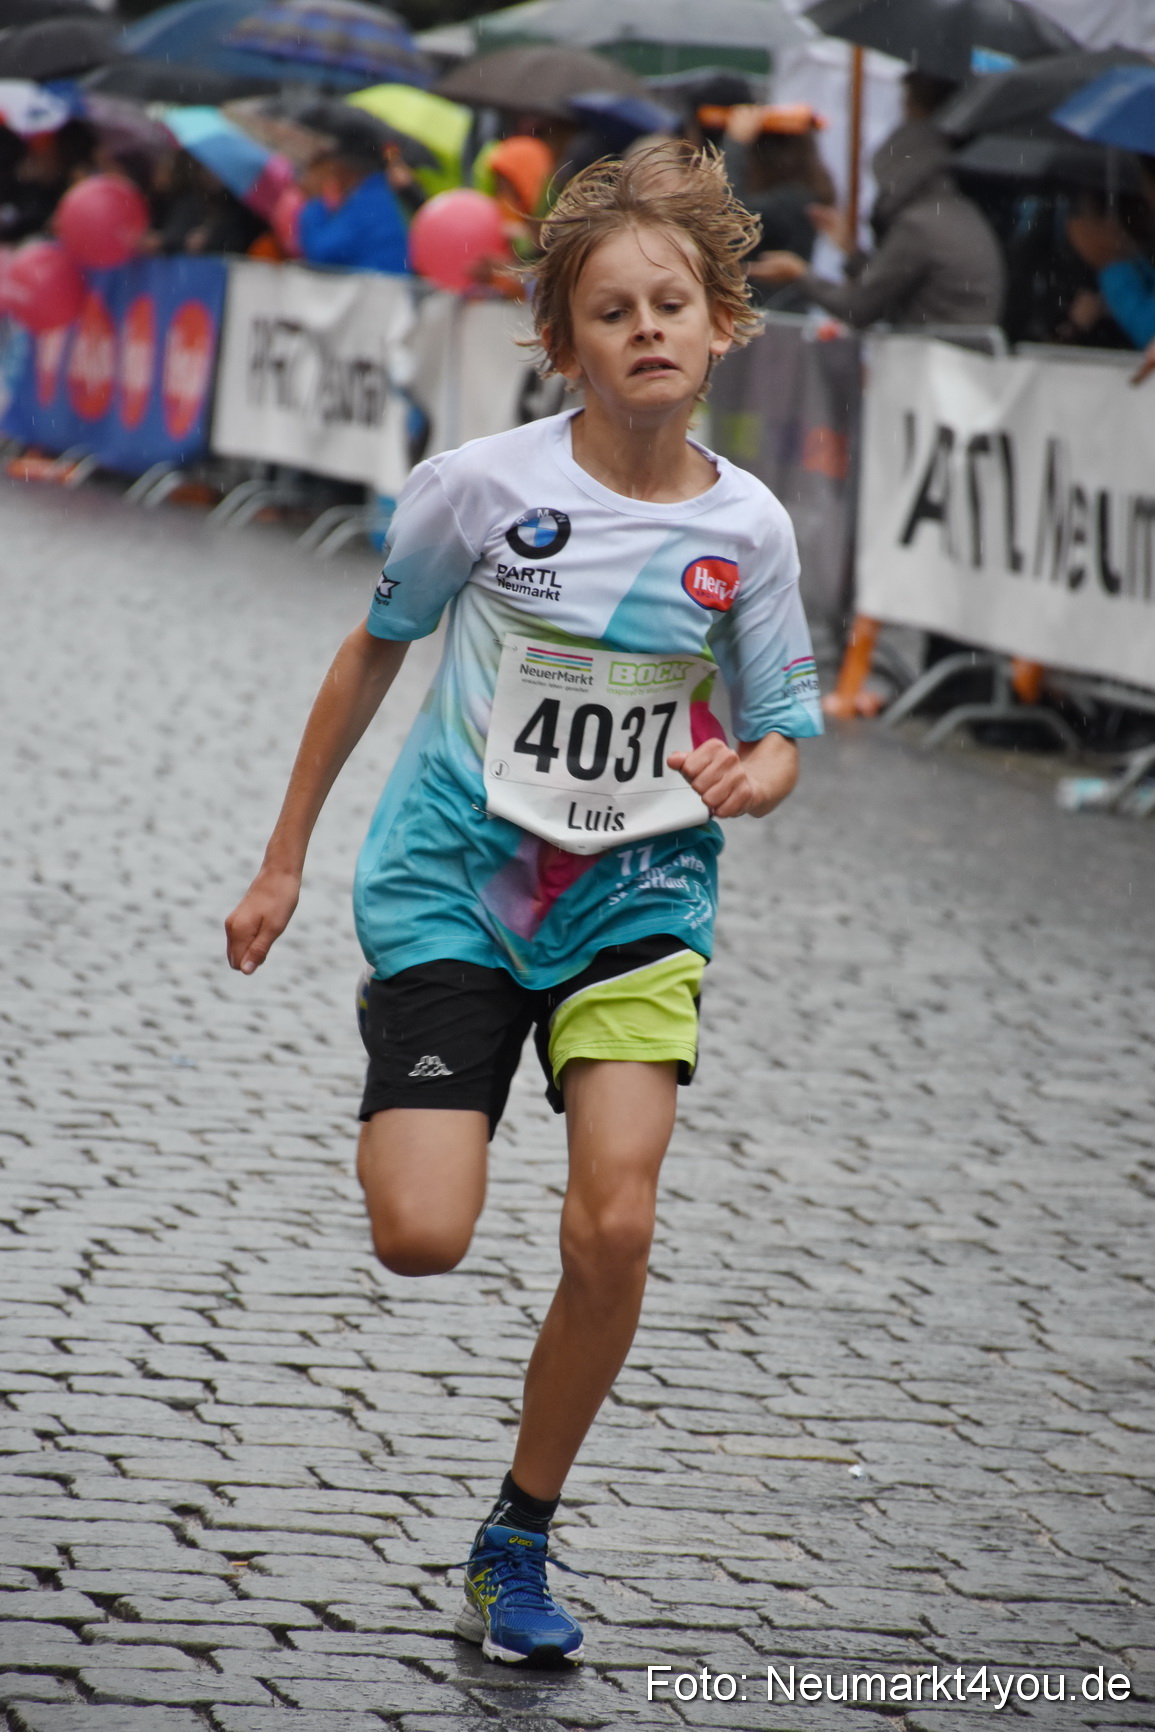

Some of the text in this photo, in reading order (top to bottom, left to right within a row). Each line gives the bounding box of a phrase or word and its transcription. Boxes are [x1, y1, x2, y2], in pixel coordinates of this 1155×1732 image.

[496, 563, 562, 589] PARTL
[497, 577, 560, 601] Neumarkt
[519, 663, 593, 686] NeuerMarkt
[608, 661, 694, 687] BOCK
[513, 698, 677, 783] 4037
[567, 801, 626, 832] Luis
